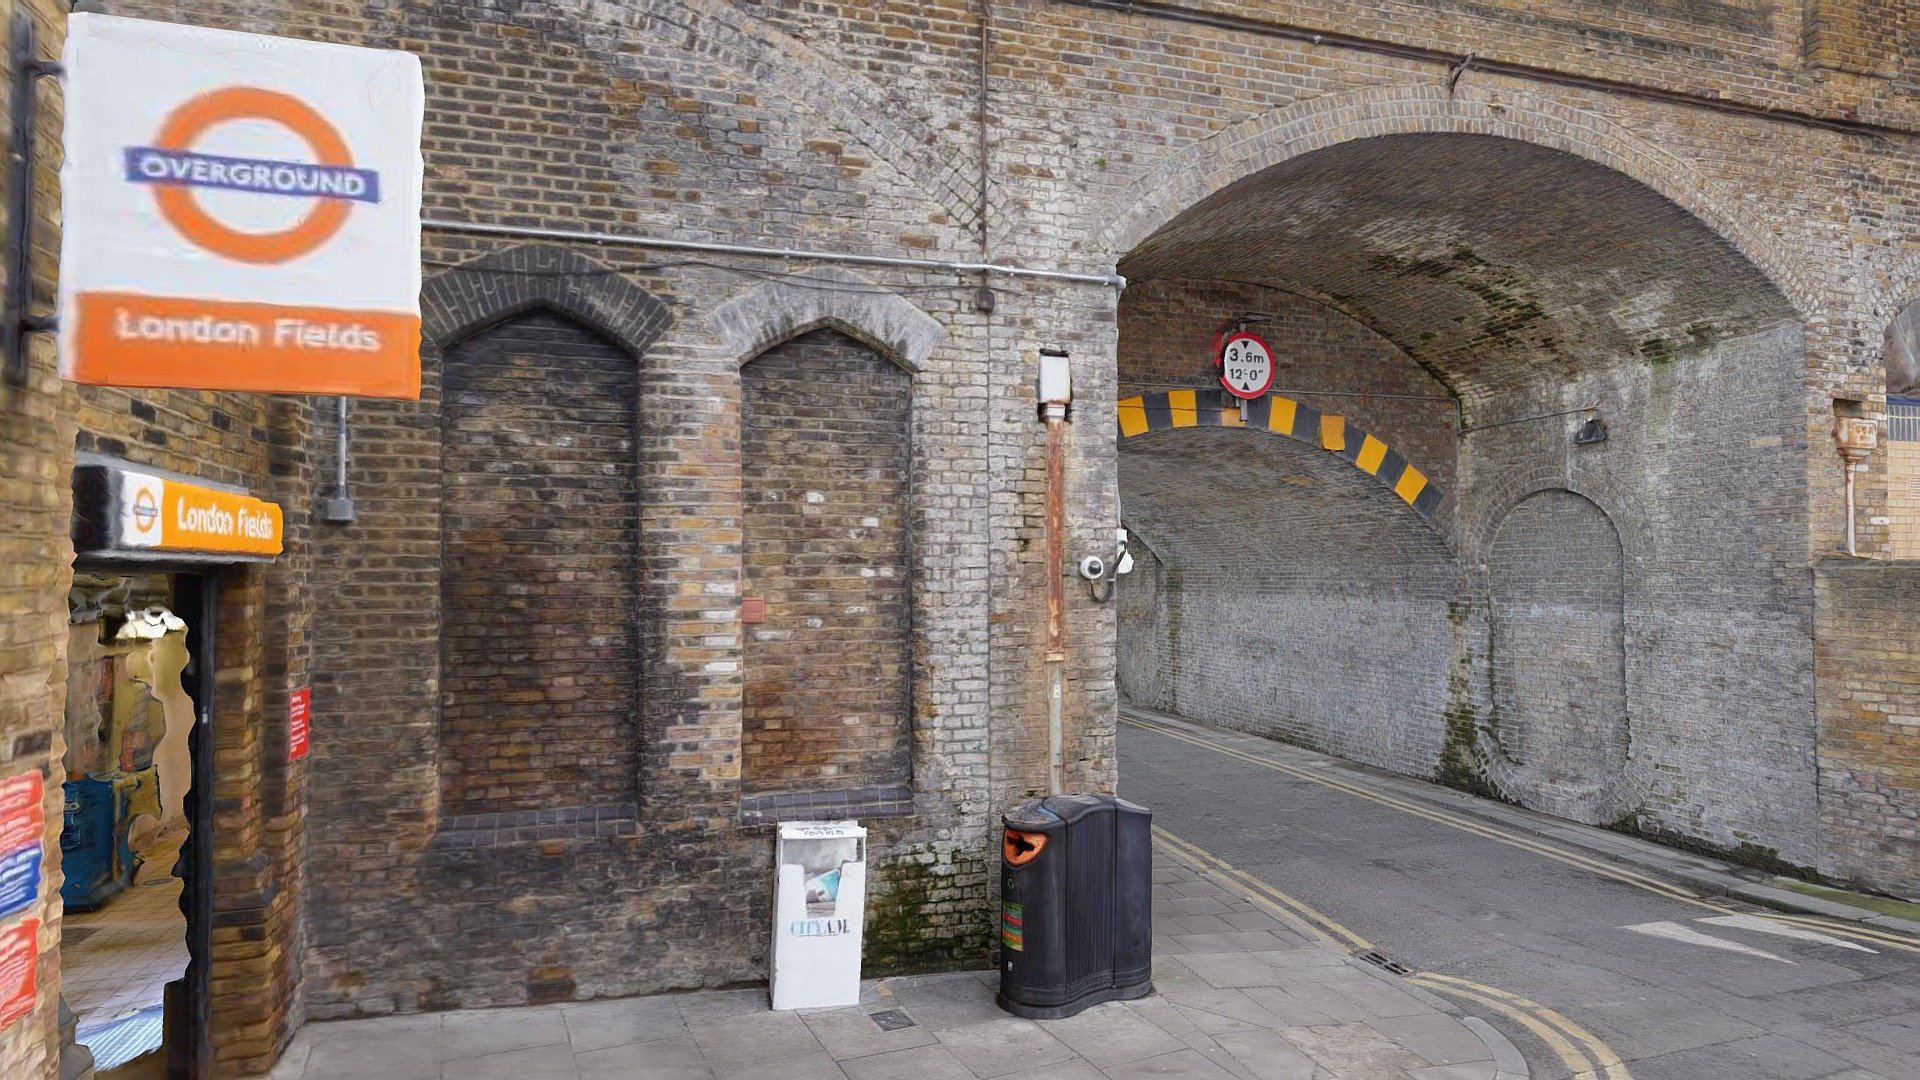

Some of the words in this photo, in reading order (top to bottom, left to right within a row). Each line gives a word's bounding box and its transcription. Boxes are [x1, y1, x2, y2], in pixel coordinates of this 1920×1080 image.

[140, 156, 366, 195] OVERGROUND
[116, 309, 259, 343] London
[274, 320, 381, 351] Fields
[1229, 348, 1264, 363] 3.6m
[177, 497, 234, 535] London
[237, 507, 274, 539] Fields
